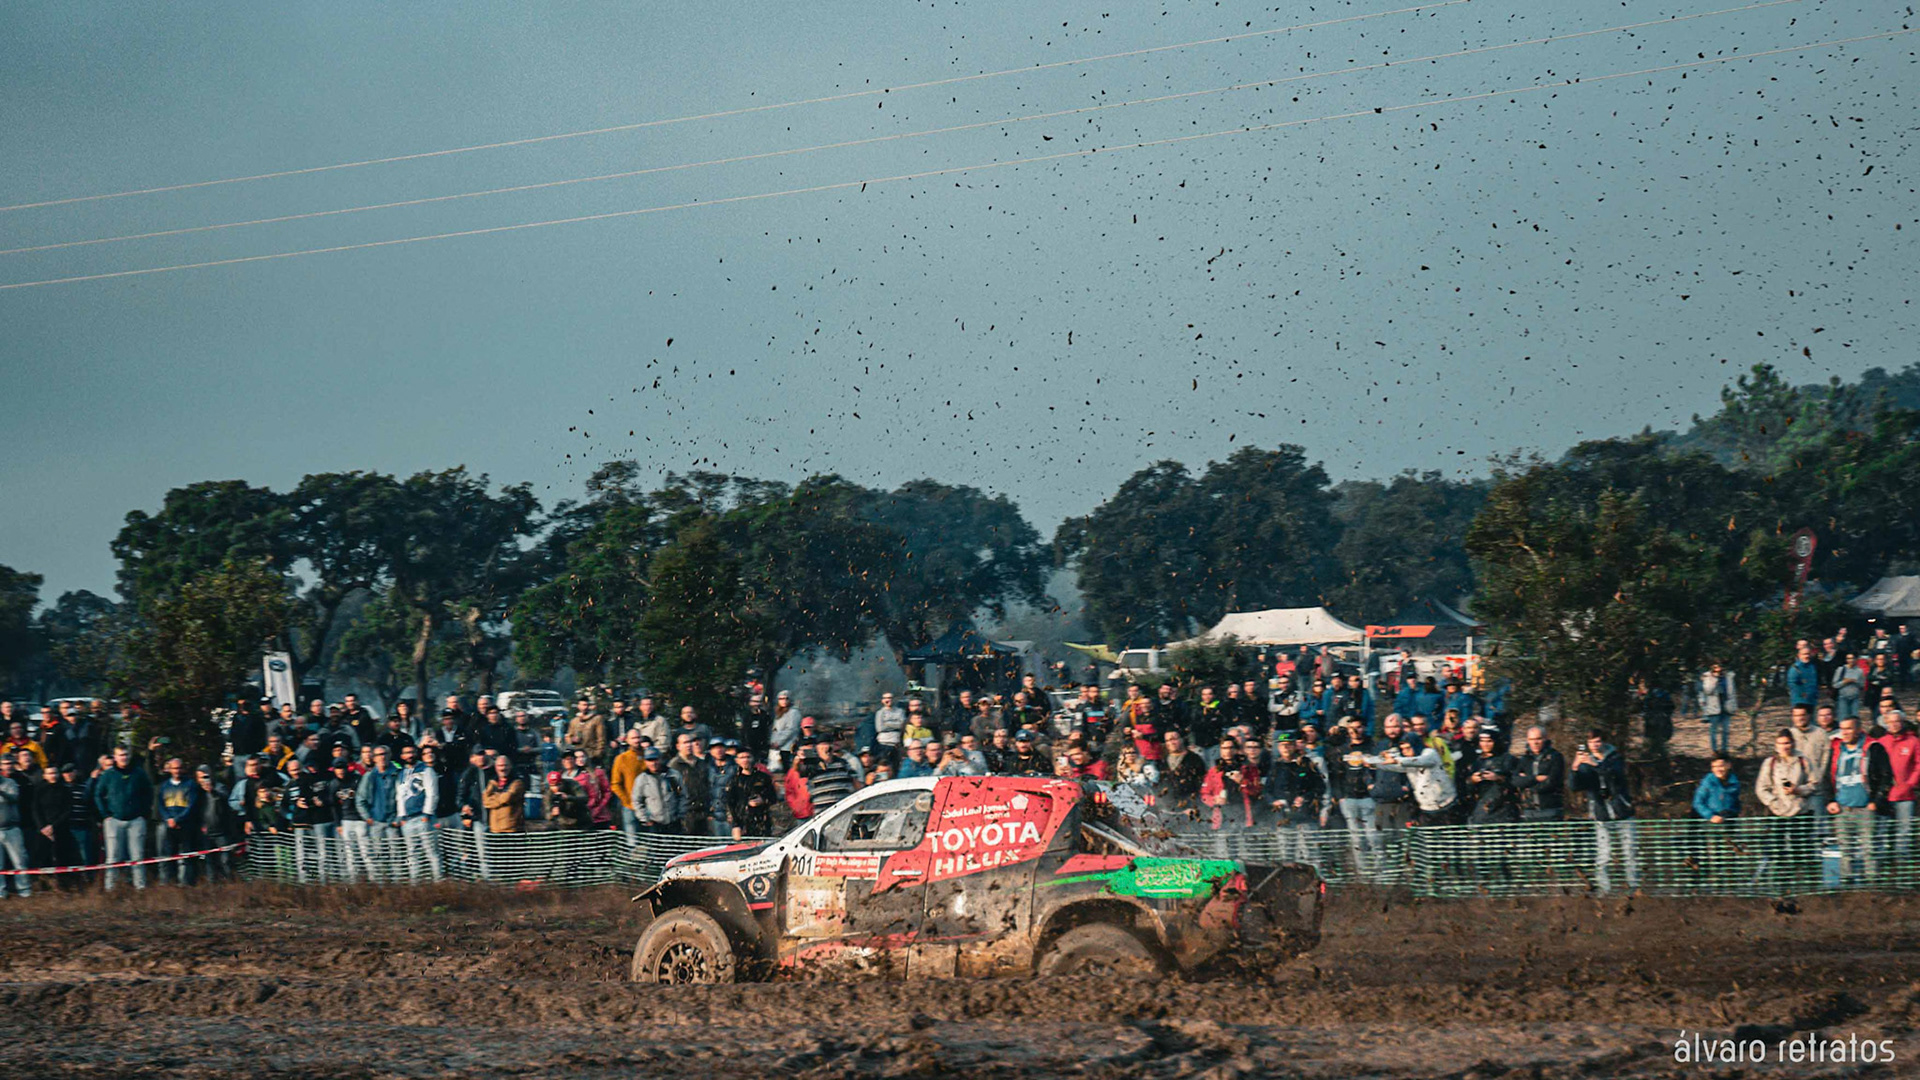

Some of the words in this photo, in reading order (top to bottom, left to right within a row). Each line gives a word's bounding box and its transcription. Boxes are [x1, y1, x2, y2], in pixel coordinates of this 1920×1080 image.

[925, 821, 1041, 853] TOYOTA
[791, 853, 813, 876] 201
[934, 848, 1022, 877] HILUX
